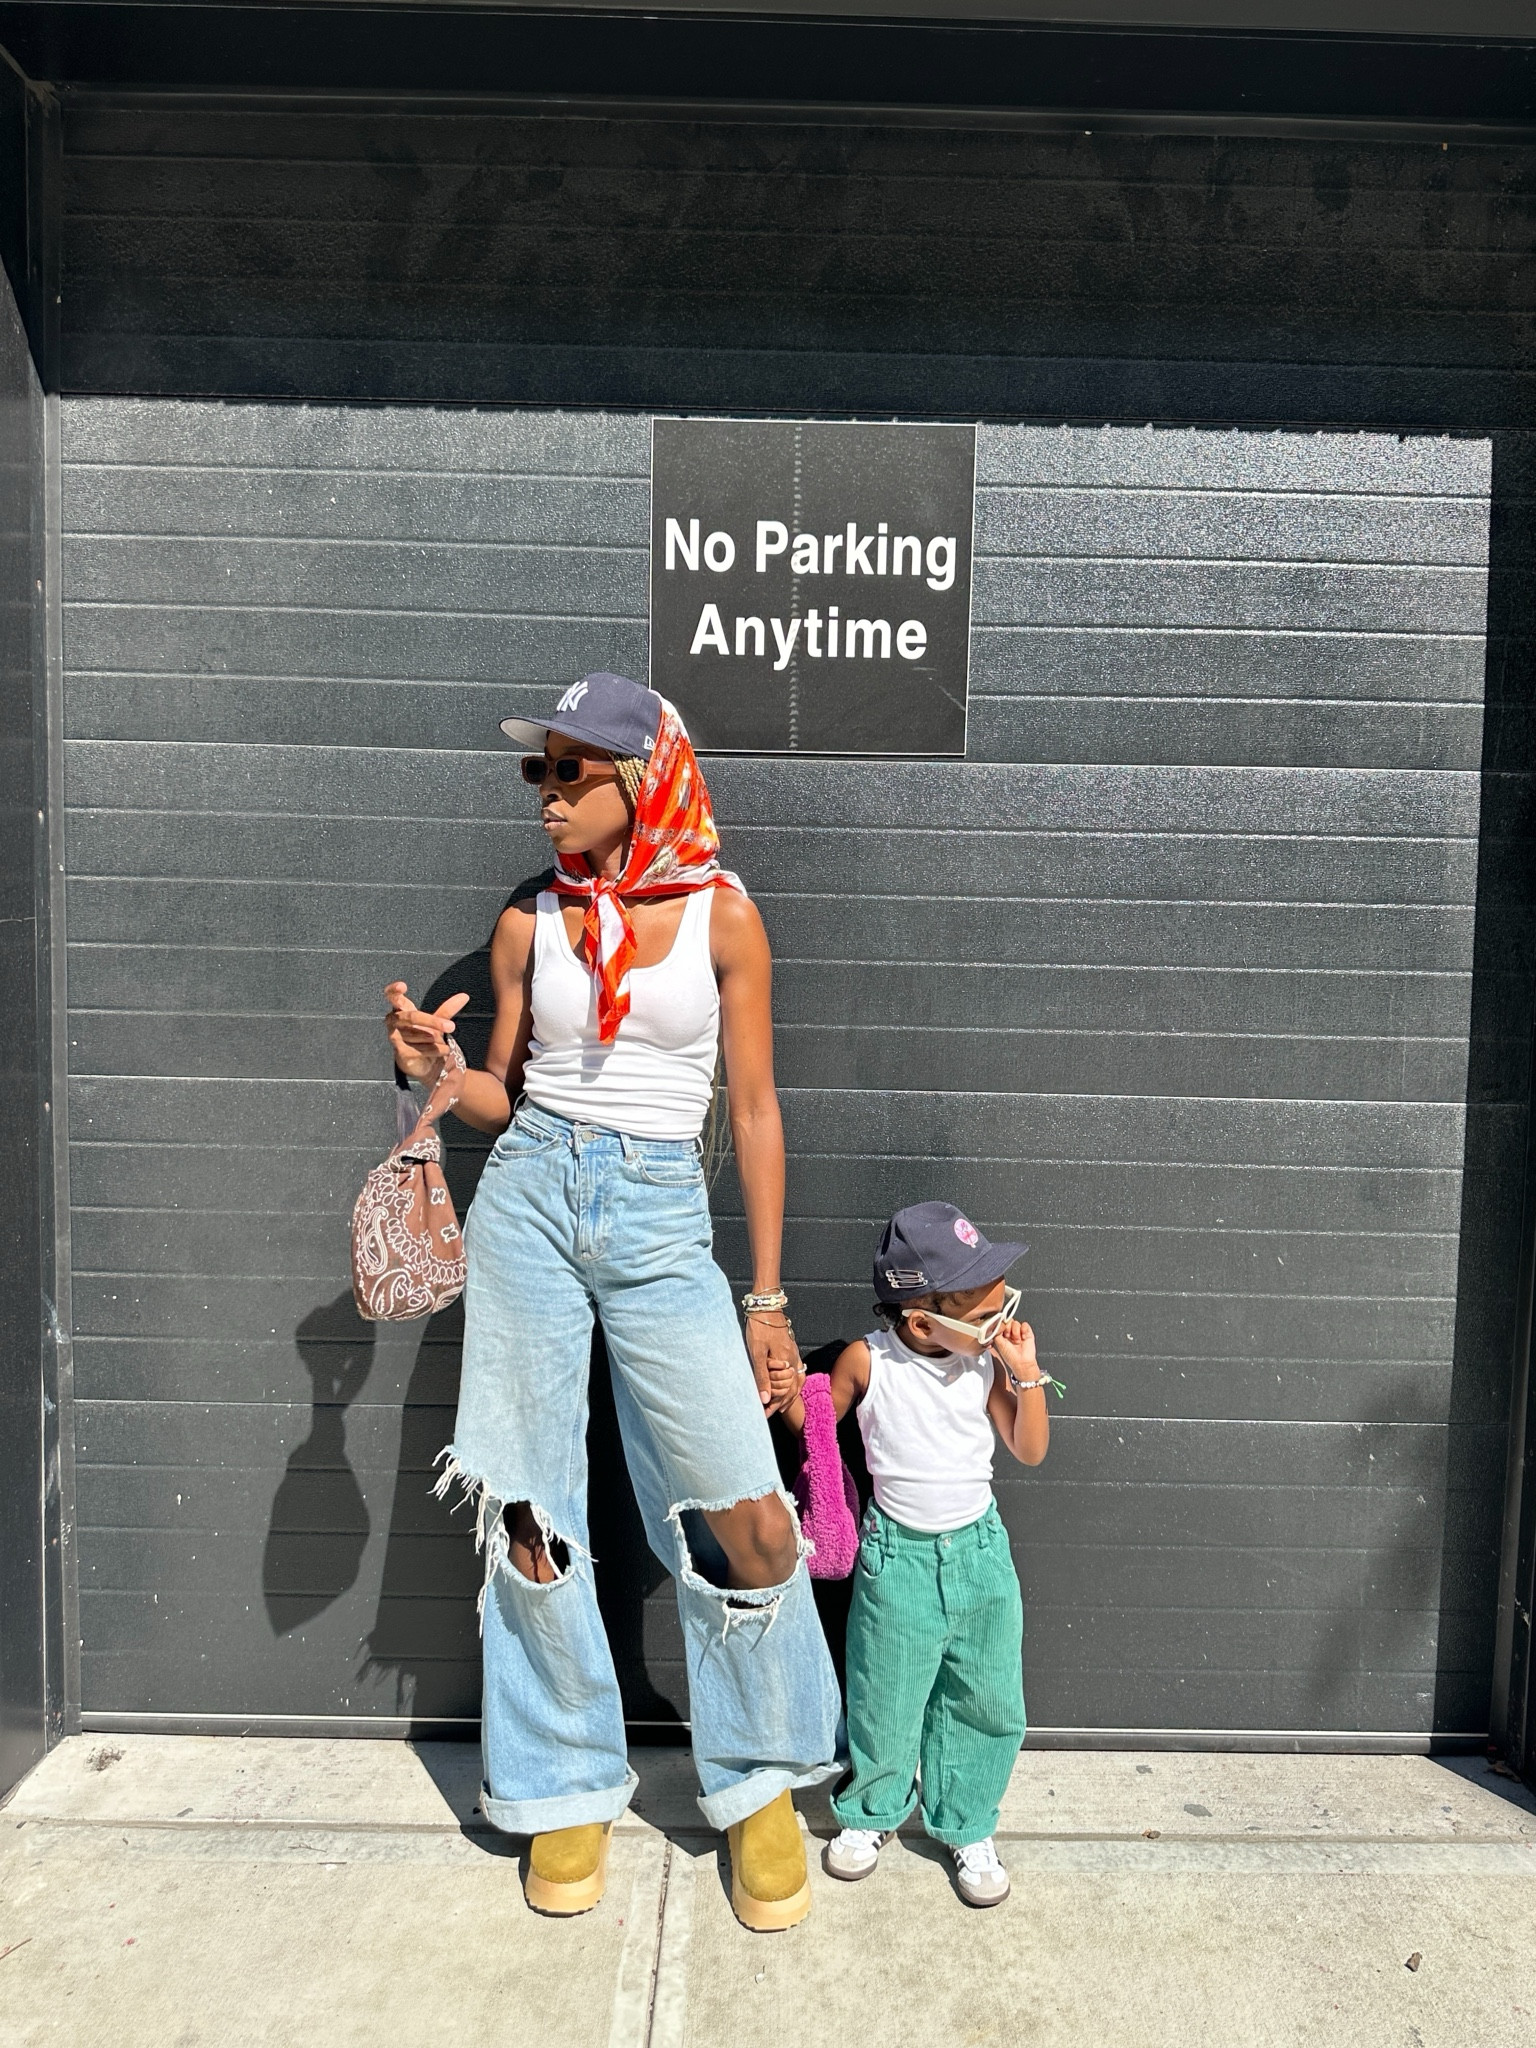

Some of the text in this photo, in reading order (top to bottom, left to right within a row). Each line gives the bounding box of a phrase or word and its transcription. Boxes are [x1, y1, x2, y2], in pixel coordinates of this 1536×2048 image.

[665, 517, 957, 591] No Parking
[689, 603, 928, 671] Anytime
[556, 680, 589, 712] NY
